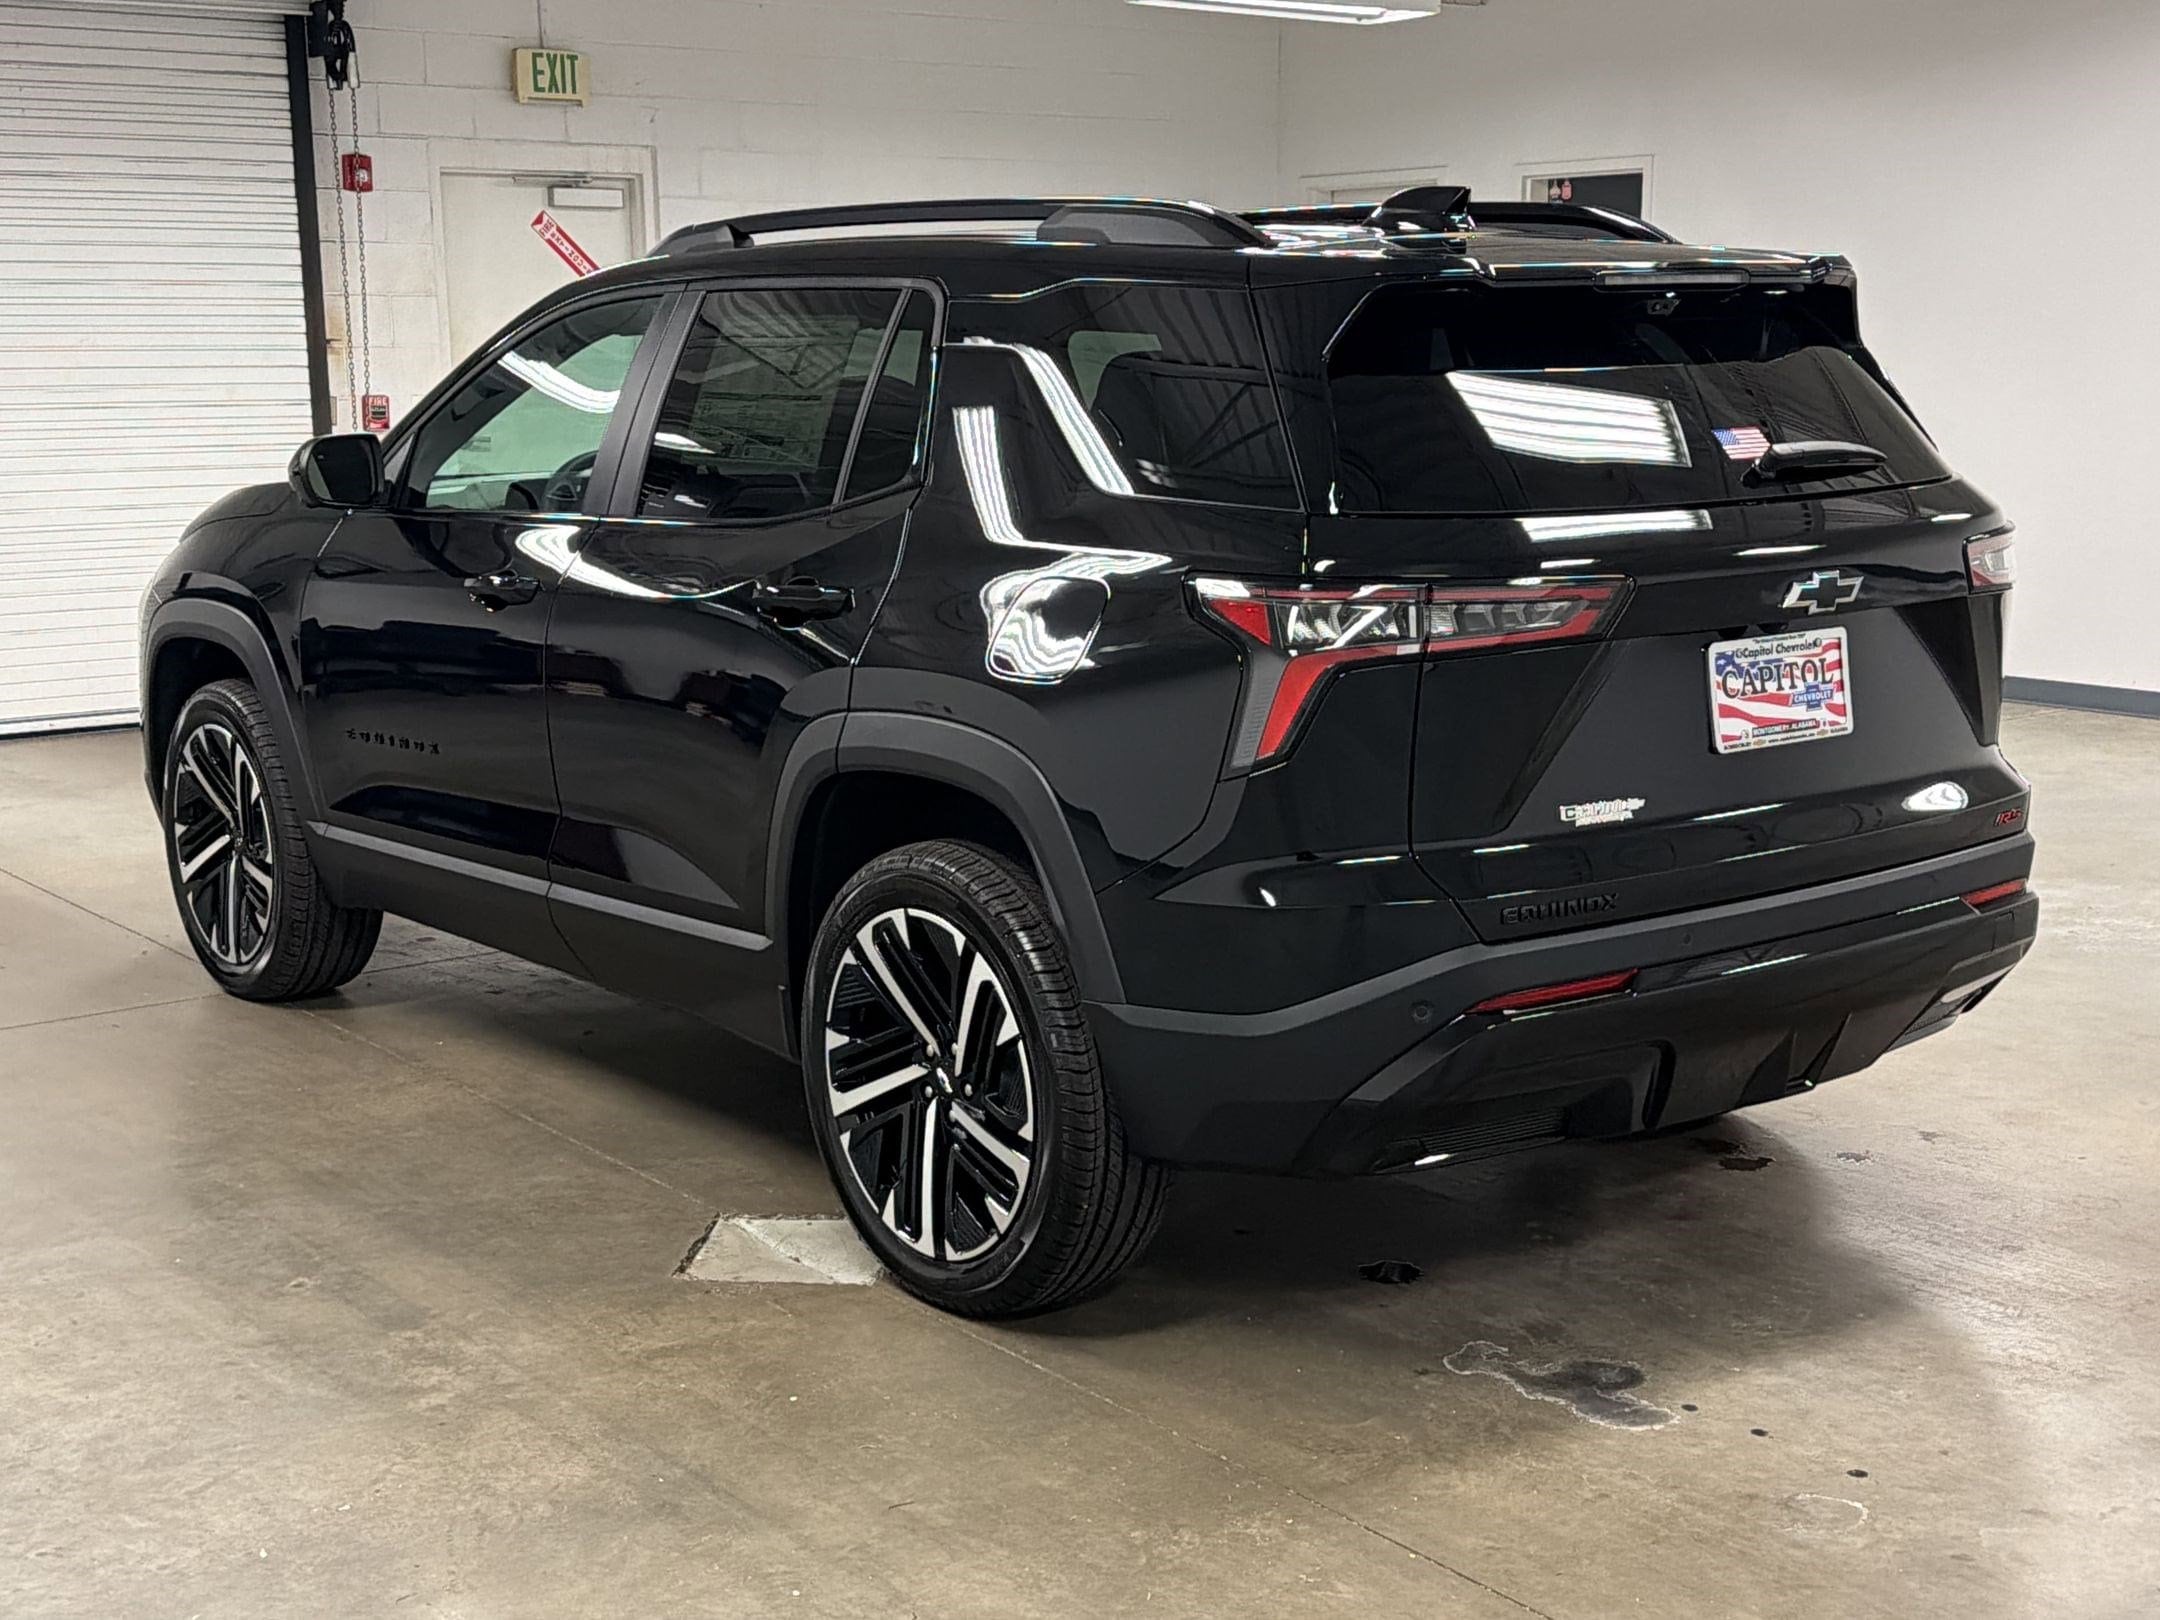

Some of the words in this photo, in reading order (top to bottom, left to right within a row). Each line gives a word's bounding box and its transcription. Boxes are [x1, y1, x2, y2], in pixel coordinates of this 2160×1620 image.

[531, 52, 579, 94] EXIT
[1742, 643, 1774, 660] Capitol
[1722, 658, 1834, 699] CAPITOL
[1793, 690, 1832, 703] CHEVROLET
[1501, 893, 1619, 924] EQUINOX
